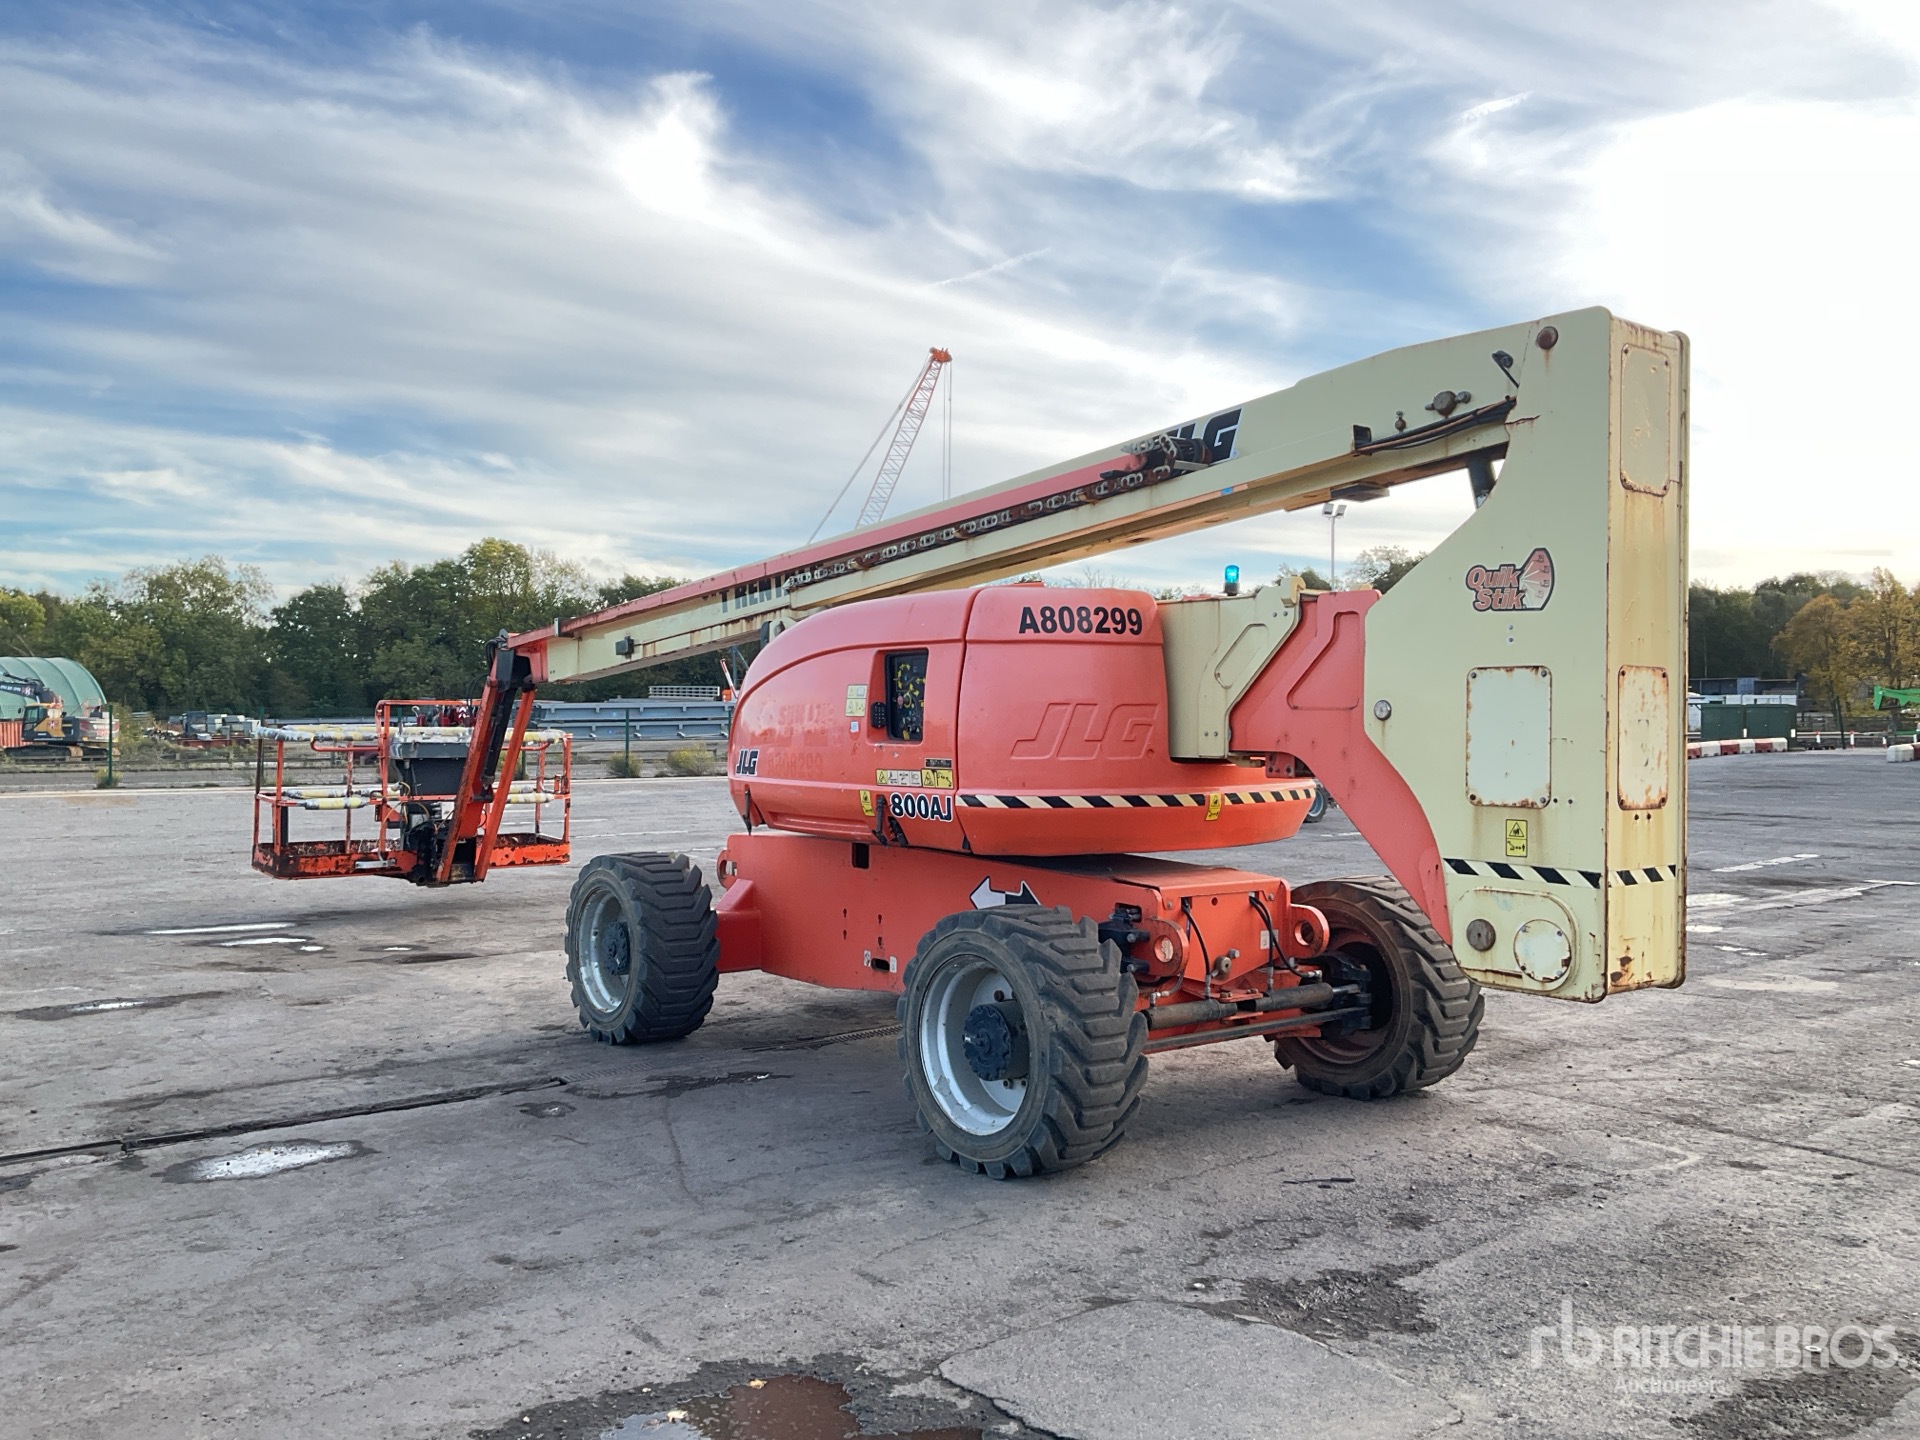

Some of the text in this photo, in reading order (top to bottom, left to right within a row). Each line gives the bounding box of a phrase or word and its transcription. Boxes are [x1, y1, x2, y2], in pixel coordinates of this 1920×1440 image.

[1467, 566, 1521, 592] Quik
[1474, 587, 1525, 611] Stik
[1018, 605, 1143, 636] A808299
[1010, 702, 1159, 761] JLG
[736, 749, 759, 775] JLG
[890, 792, 953, 822] 800AJ
